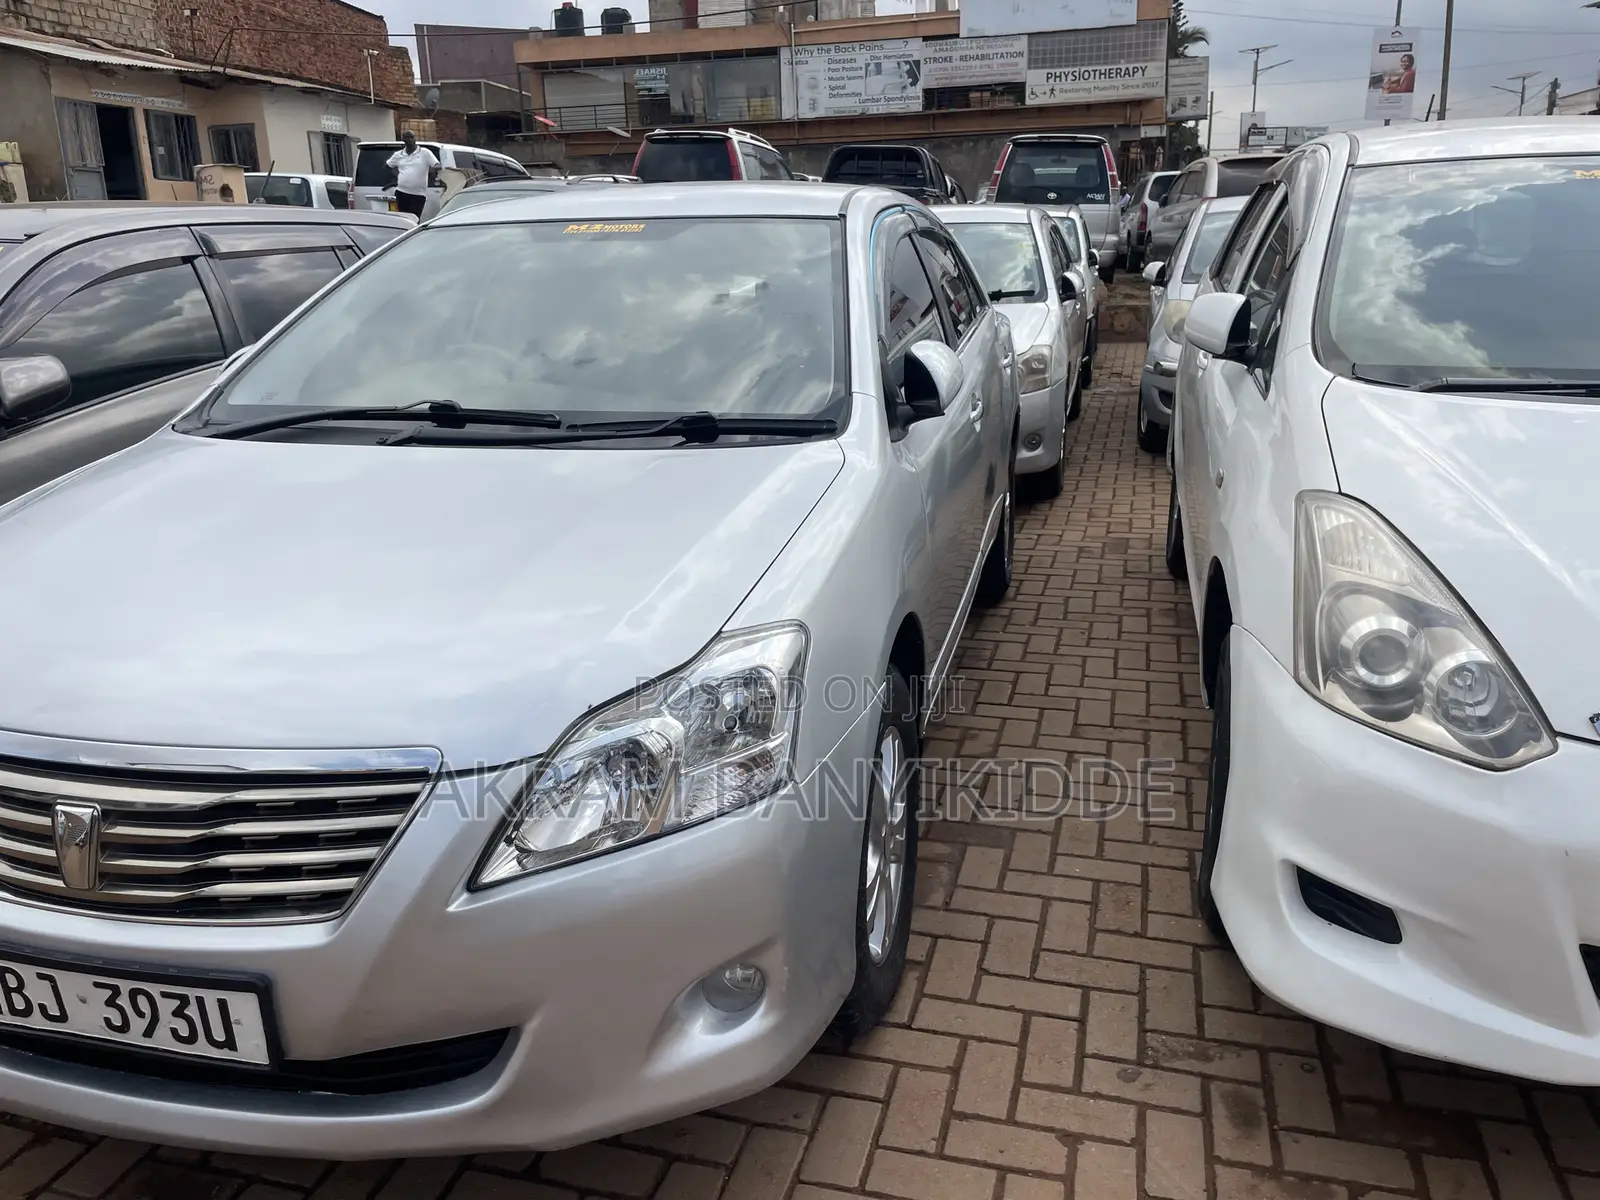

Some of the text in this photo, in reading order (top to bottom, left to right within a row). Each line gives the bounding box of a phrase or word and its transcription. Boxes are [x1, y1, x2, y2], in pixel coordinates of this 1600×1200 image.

[794, 47, 815, 58] Why
[817, 45, 832, 55] the
[834, 44, 856, 54] Back
[859, 42, 885, 53] Pains
[827, 57, 857, 65] Diseases
[923, 55, 954, 65] STROKE
[959, 51, 1025, 62] REHABILITATION
[828, 84, 847, 92] Spinal
[1121, 82, 1140, 91] Since
[858, 96, 882, 105] Lumbar
[92, 980, 239, 1052] 393U
